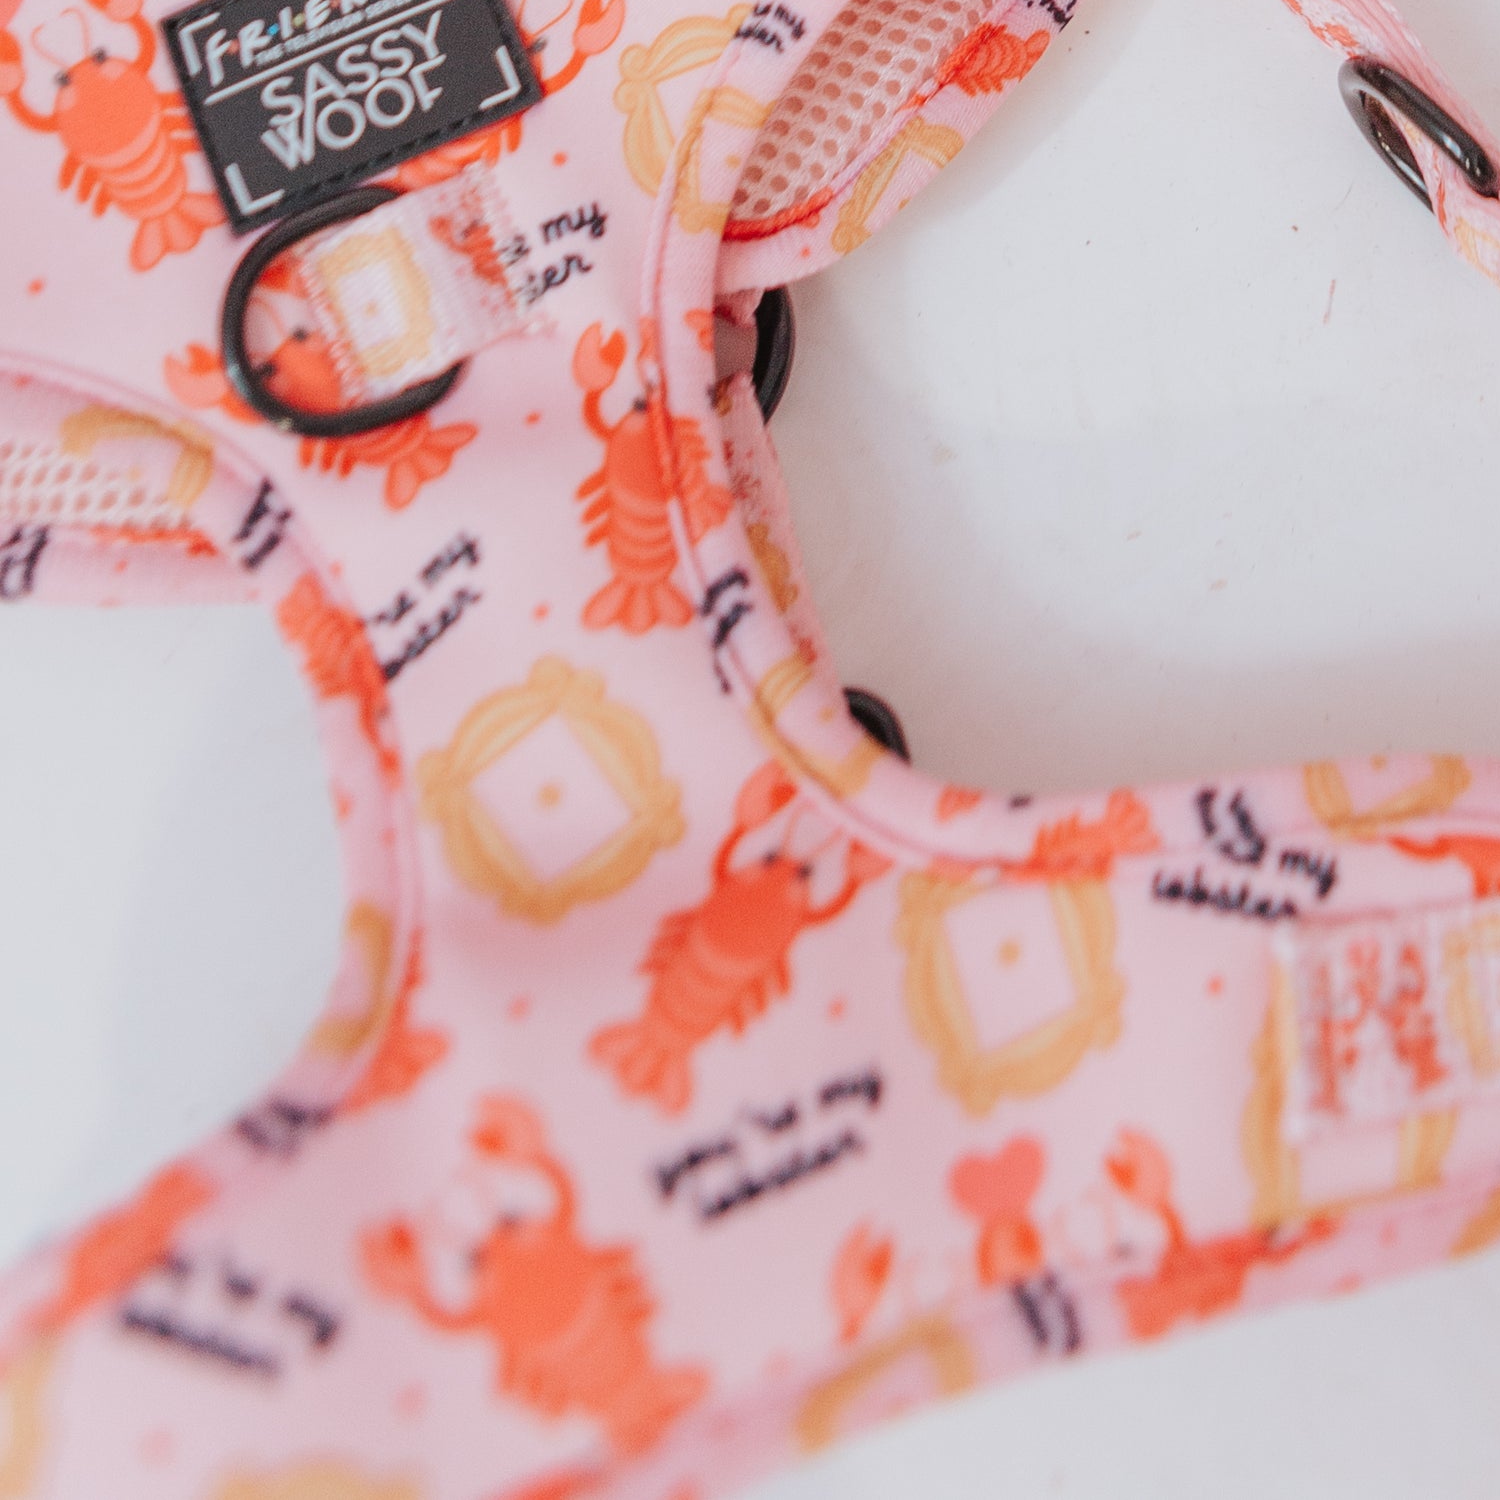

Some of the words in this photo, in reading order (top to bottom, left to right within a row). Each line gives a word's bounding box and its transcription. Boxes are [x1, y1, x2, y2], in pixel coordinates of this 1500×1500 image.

[259, 8, 444, 129] SASSY
[259, 53, 448, 171] WOOF
[539, 200, 609, 245] my
